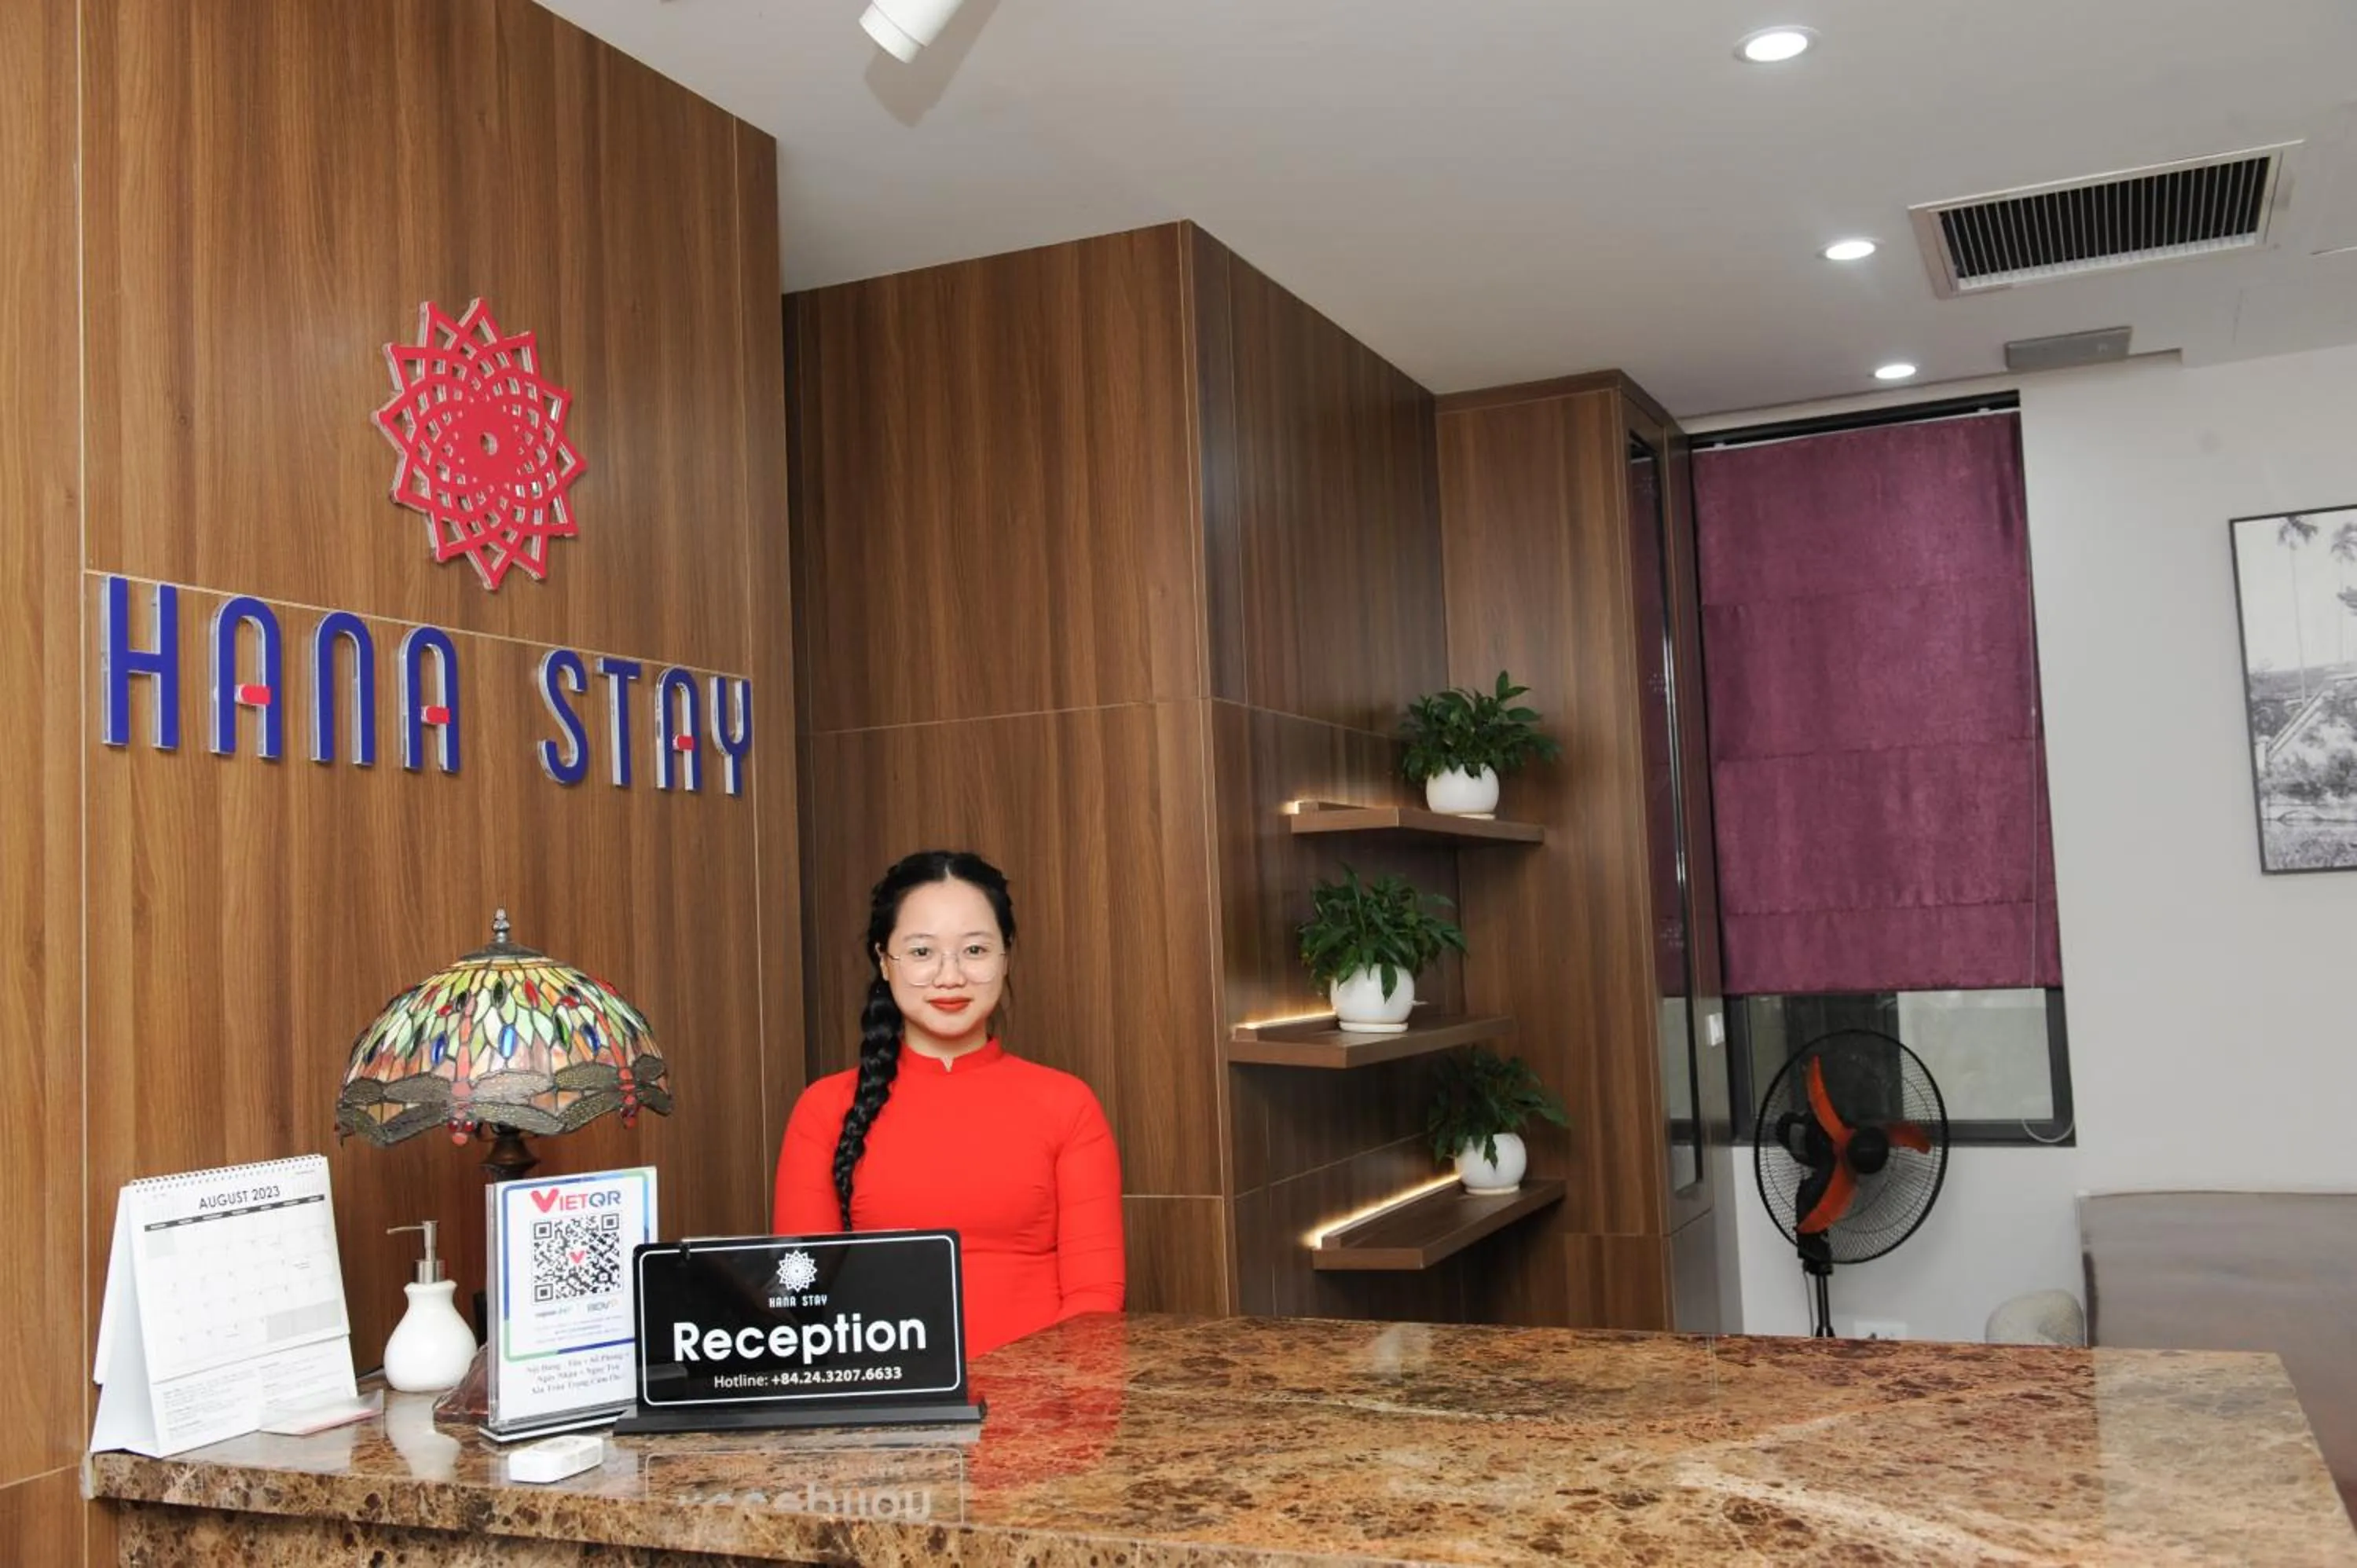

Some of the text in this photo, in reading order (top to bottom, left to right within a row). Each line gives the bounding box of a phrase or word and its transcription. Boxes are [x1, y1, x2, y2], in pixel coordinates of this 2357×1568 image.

[102, 574, 753, 796] HANA STAY
[199, 1185, 280, 1210] AUGUST 2023
[769, 1294, 827, 1308] HANA STAY
[673, 1313, 926, 1364] Reception
[714, 1366, 904, 1389] Hotline: +84.24.3207.6633
